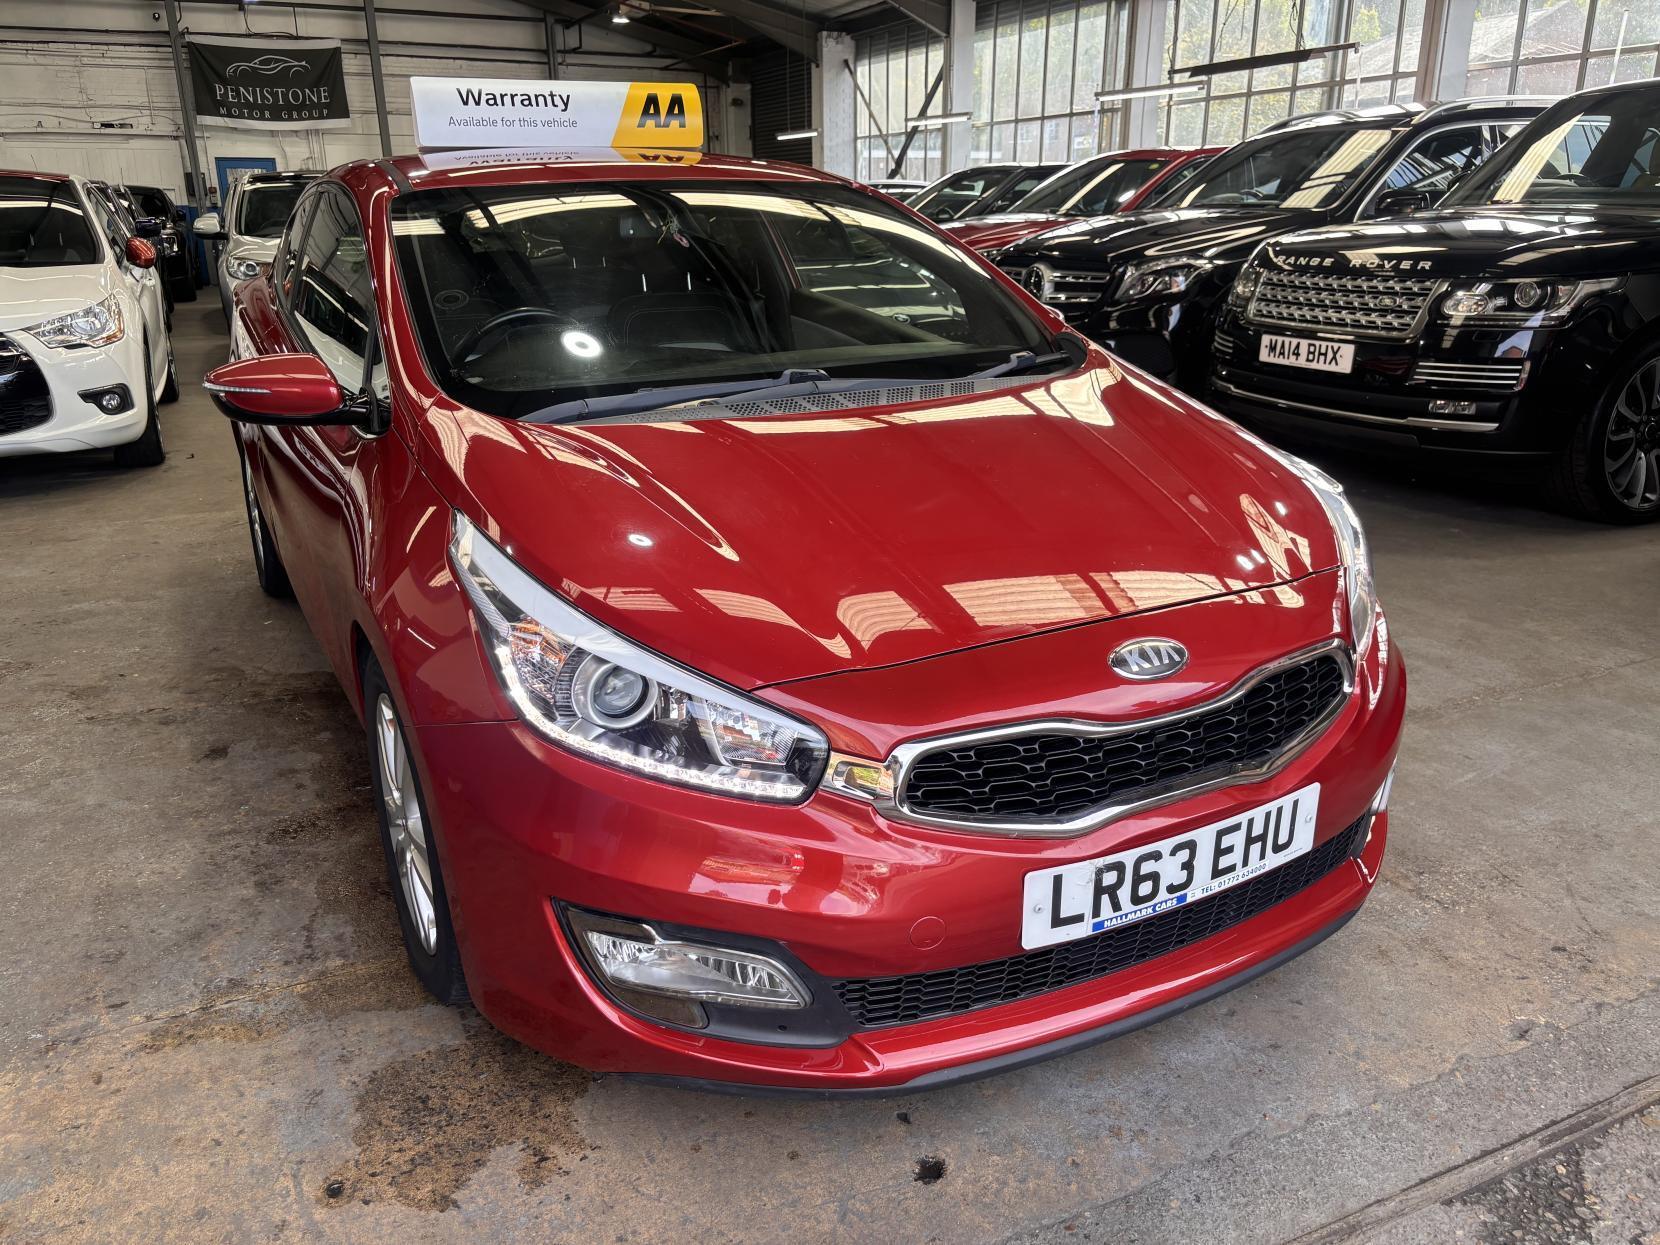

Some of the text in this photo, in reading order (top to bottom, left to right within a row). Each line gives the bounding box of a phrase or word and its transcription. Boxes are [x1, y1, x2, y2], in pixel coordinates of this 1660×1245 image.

[214, 83, 330, 105] PENISTONE
[456, 87, 571, 112] Warranty
[219, 106, 329, 119] MOTOR GROUP
[448, 115, 578, 129] Available for this vehicle
[636, 92, 687, 129] AA
[1276, 255, 1433, 270] RANGE ROVER
[1268, 338, 1341, 366] MA14 BHX
[1121, 645, 1182, 672] KIA
[1050, 798, 1300, 930] LR63 EHU
[1200, 863, 1267, 894] TEL: 01772 634000
[1103, 898, 1178, 929] HALLMARK CARS
